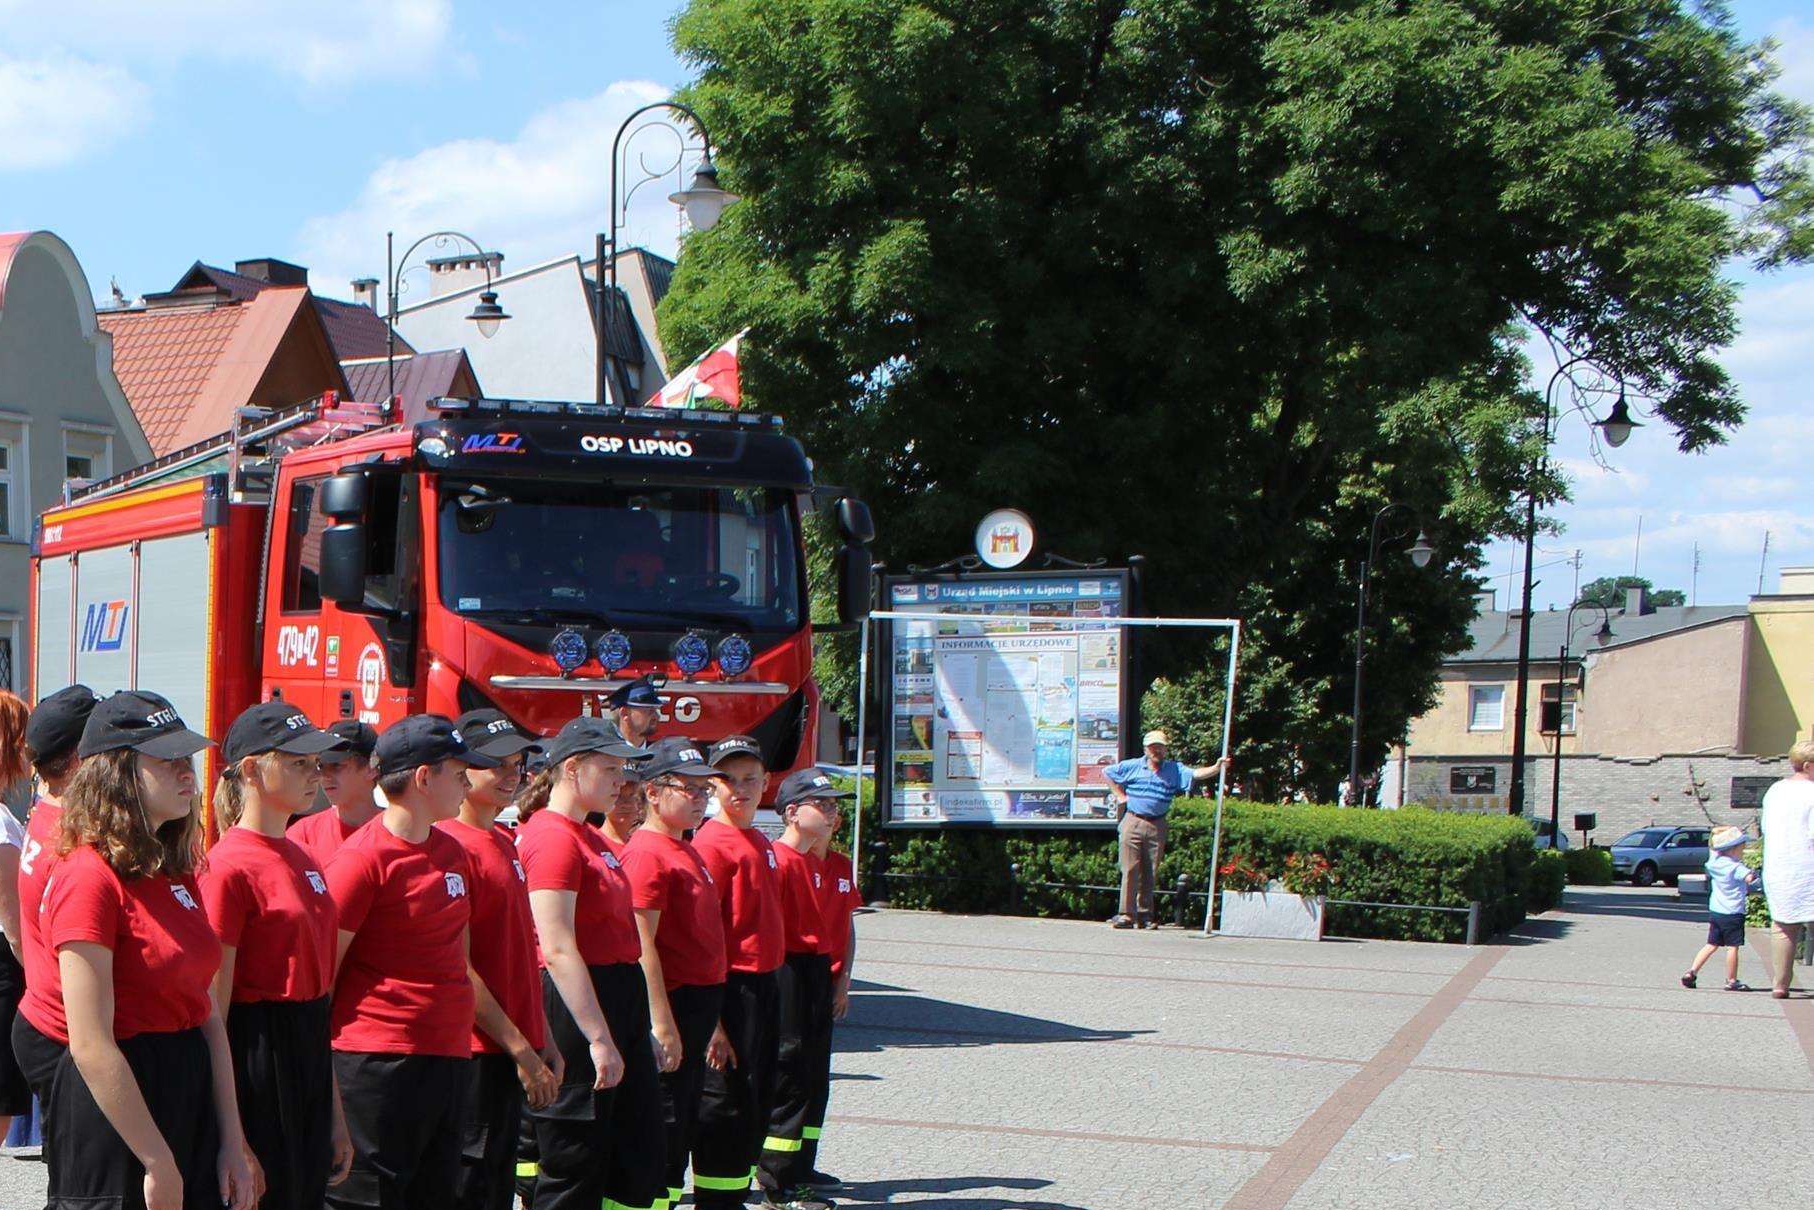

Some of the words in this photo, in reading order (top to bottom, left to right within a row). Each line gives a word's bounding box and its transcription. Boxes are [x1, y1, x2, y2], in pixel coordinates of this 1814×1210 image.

[580, 435, 623, 453] OSP
[628, 438, 693, 458] LIPNO
[942, 586, 976, 599] Urząd
[978, 585, 1020, 598] Miejski
[1023, 587, 1035, 595] w
[1037, 584, 1074, 596] Lipnie
[277, 625, 319, 667] 47942
[942, 639, 1007, 649] INFORMACJE
[1011, 638, 1071, 648] URZĘDOWE
